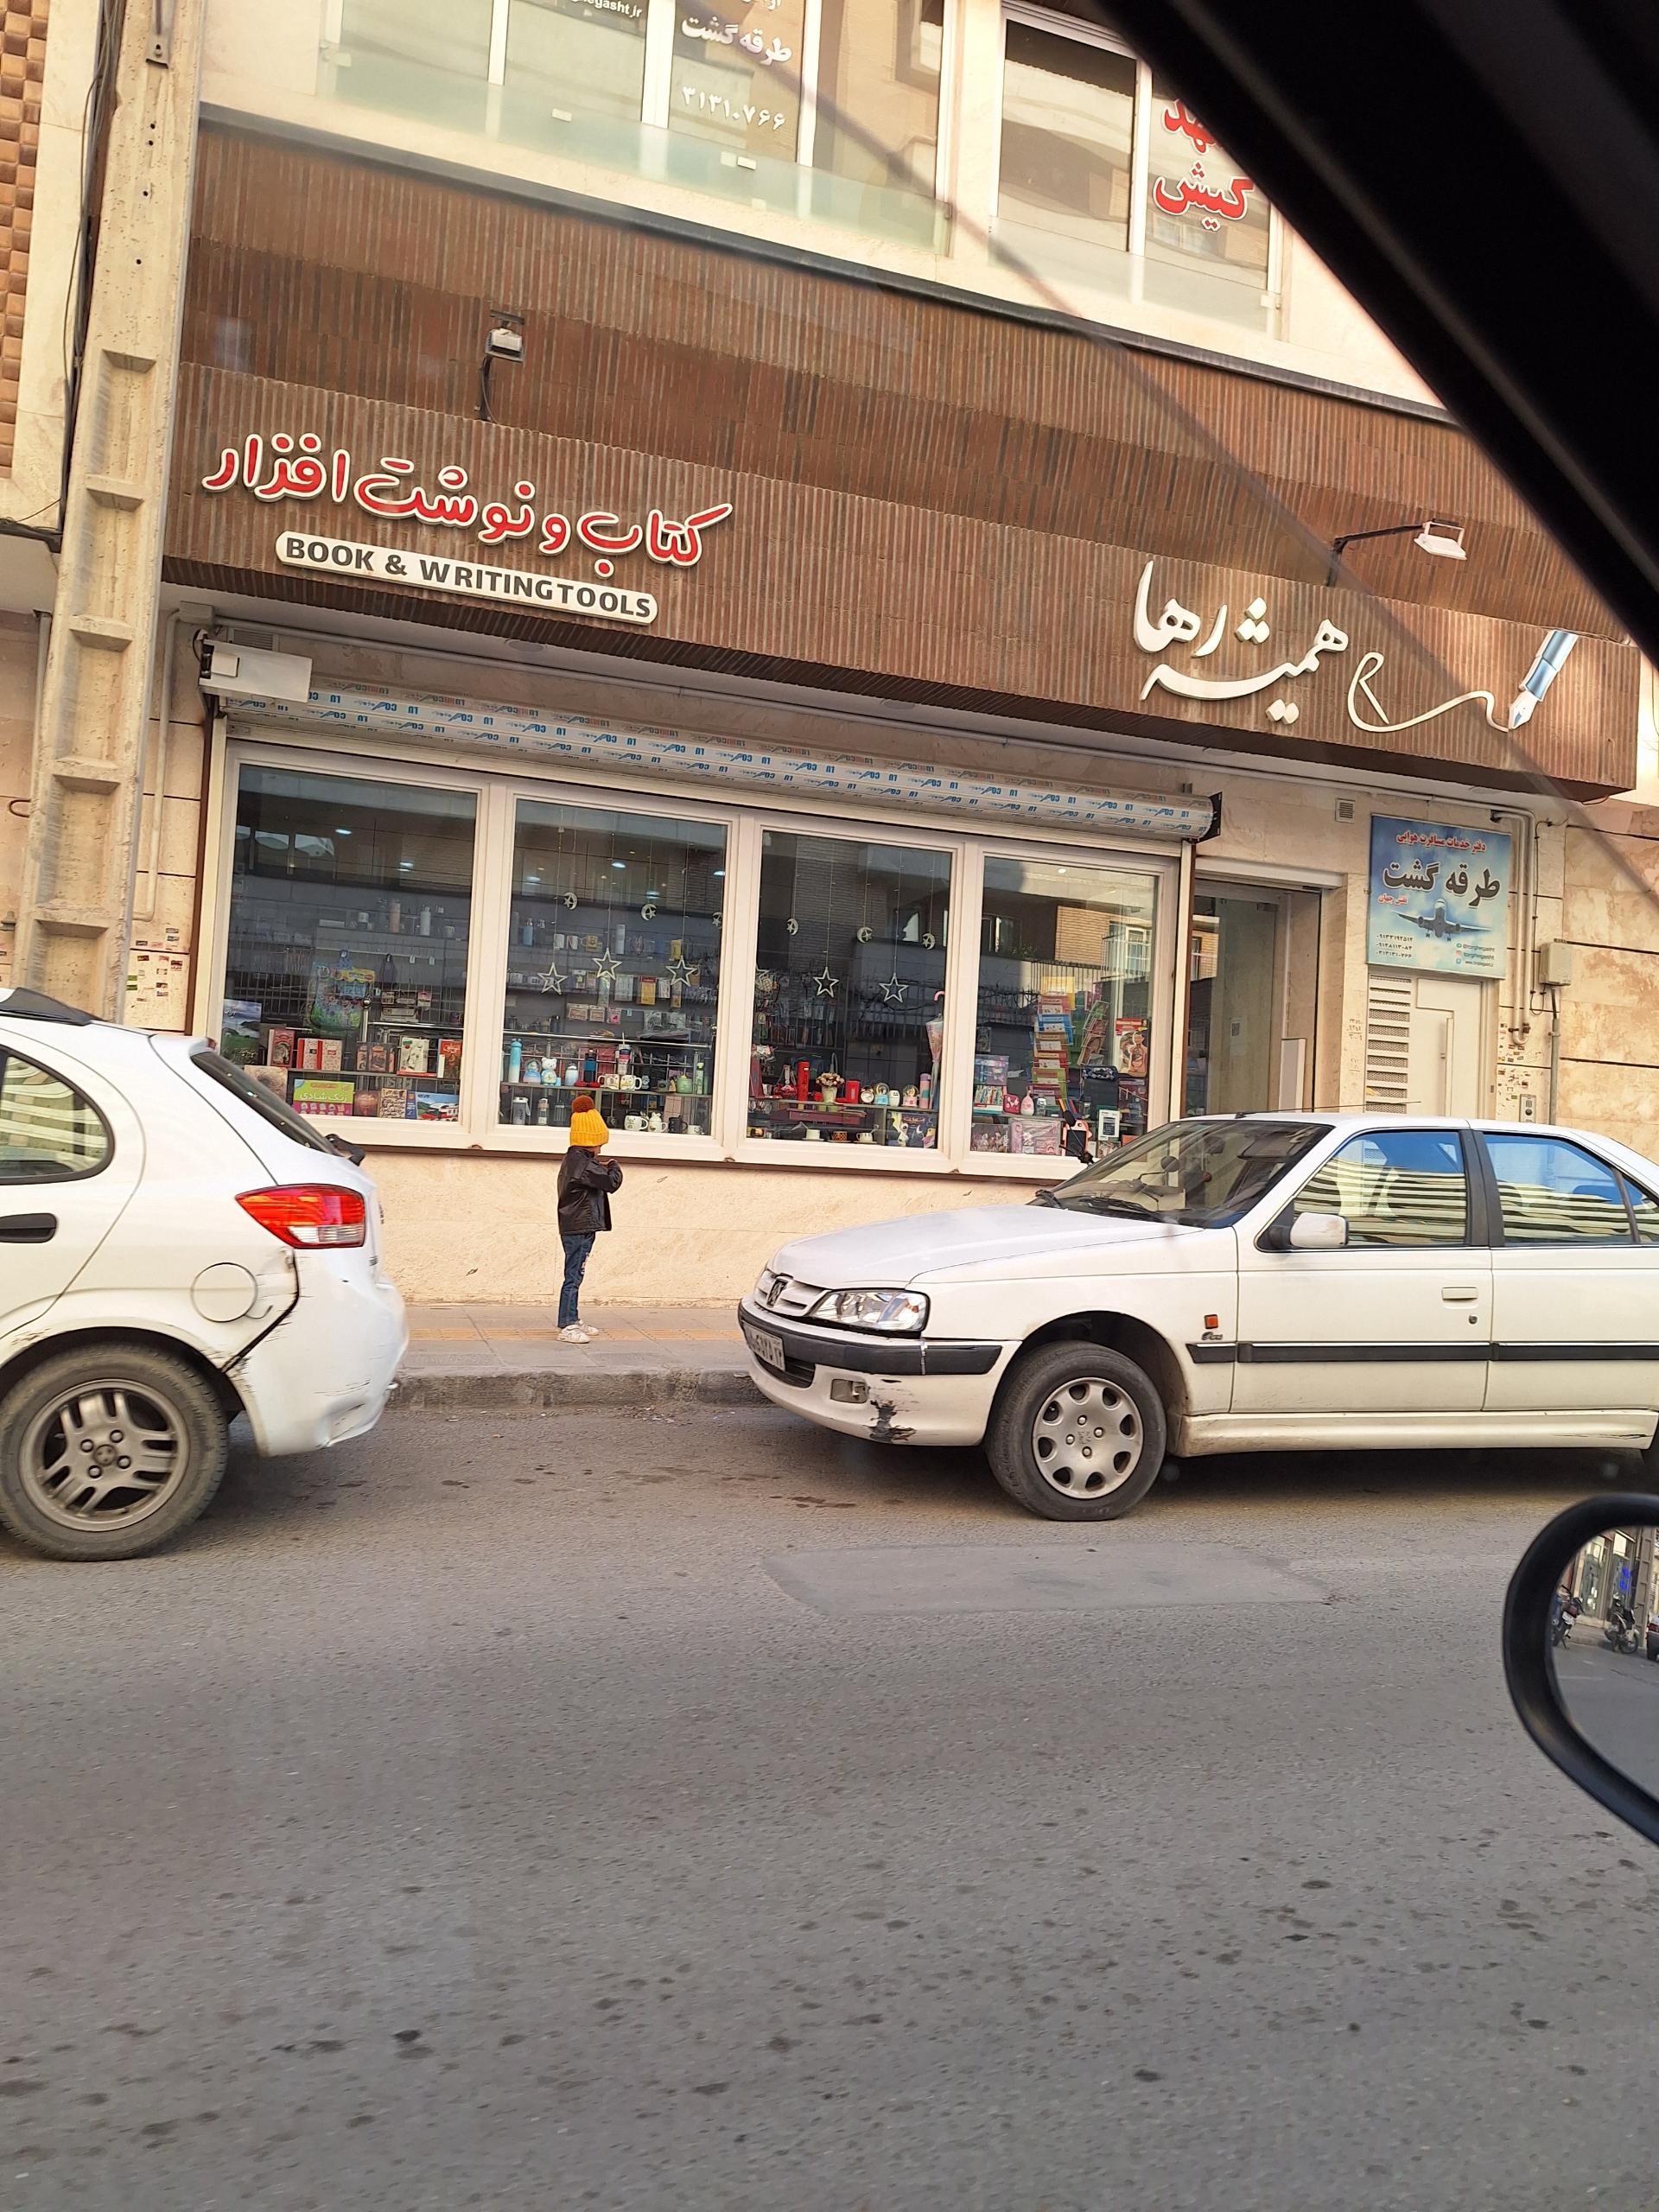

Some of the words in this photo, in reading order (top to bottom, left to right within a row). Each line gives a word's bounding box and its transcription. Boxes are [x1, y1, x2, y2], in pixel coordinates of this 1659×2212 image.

[682, 16, 739, 45] گشت
[682, 86, 785, 130] ۳۱۳۱۰۷۶۶
[1154, 161, 1254, 231] کیش
[202, 433, 350, 503] افزار
[353, 456, 536, 545] نوشت
[285, 537, 375, 571] BOOK
[385, 554, 408, 576] &
[539, 513, 571, 556] و
[577, 504, 733, 579] کتاب
[1134, 560, 1227, 658] رها
[1383, 858, 1440, 891] گشت
